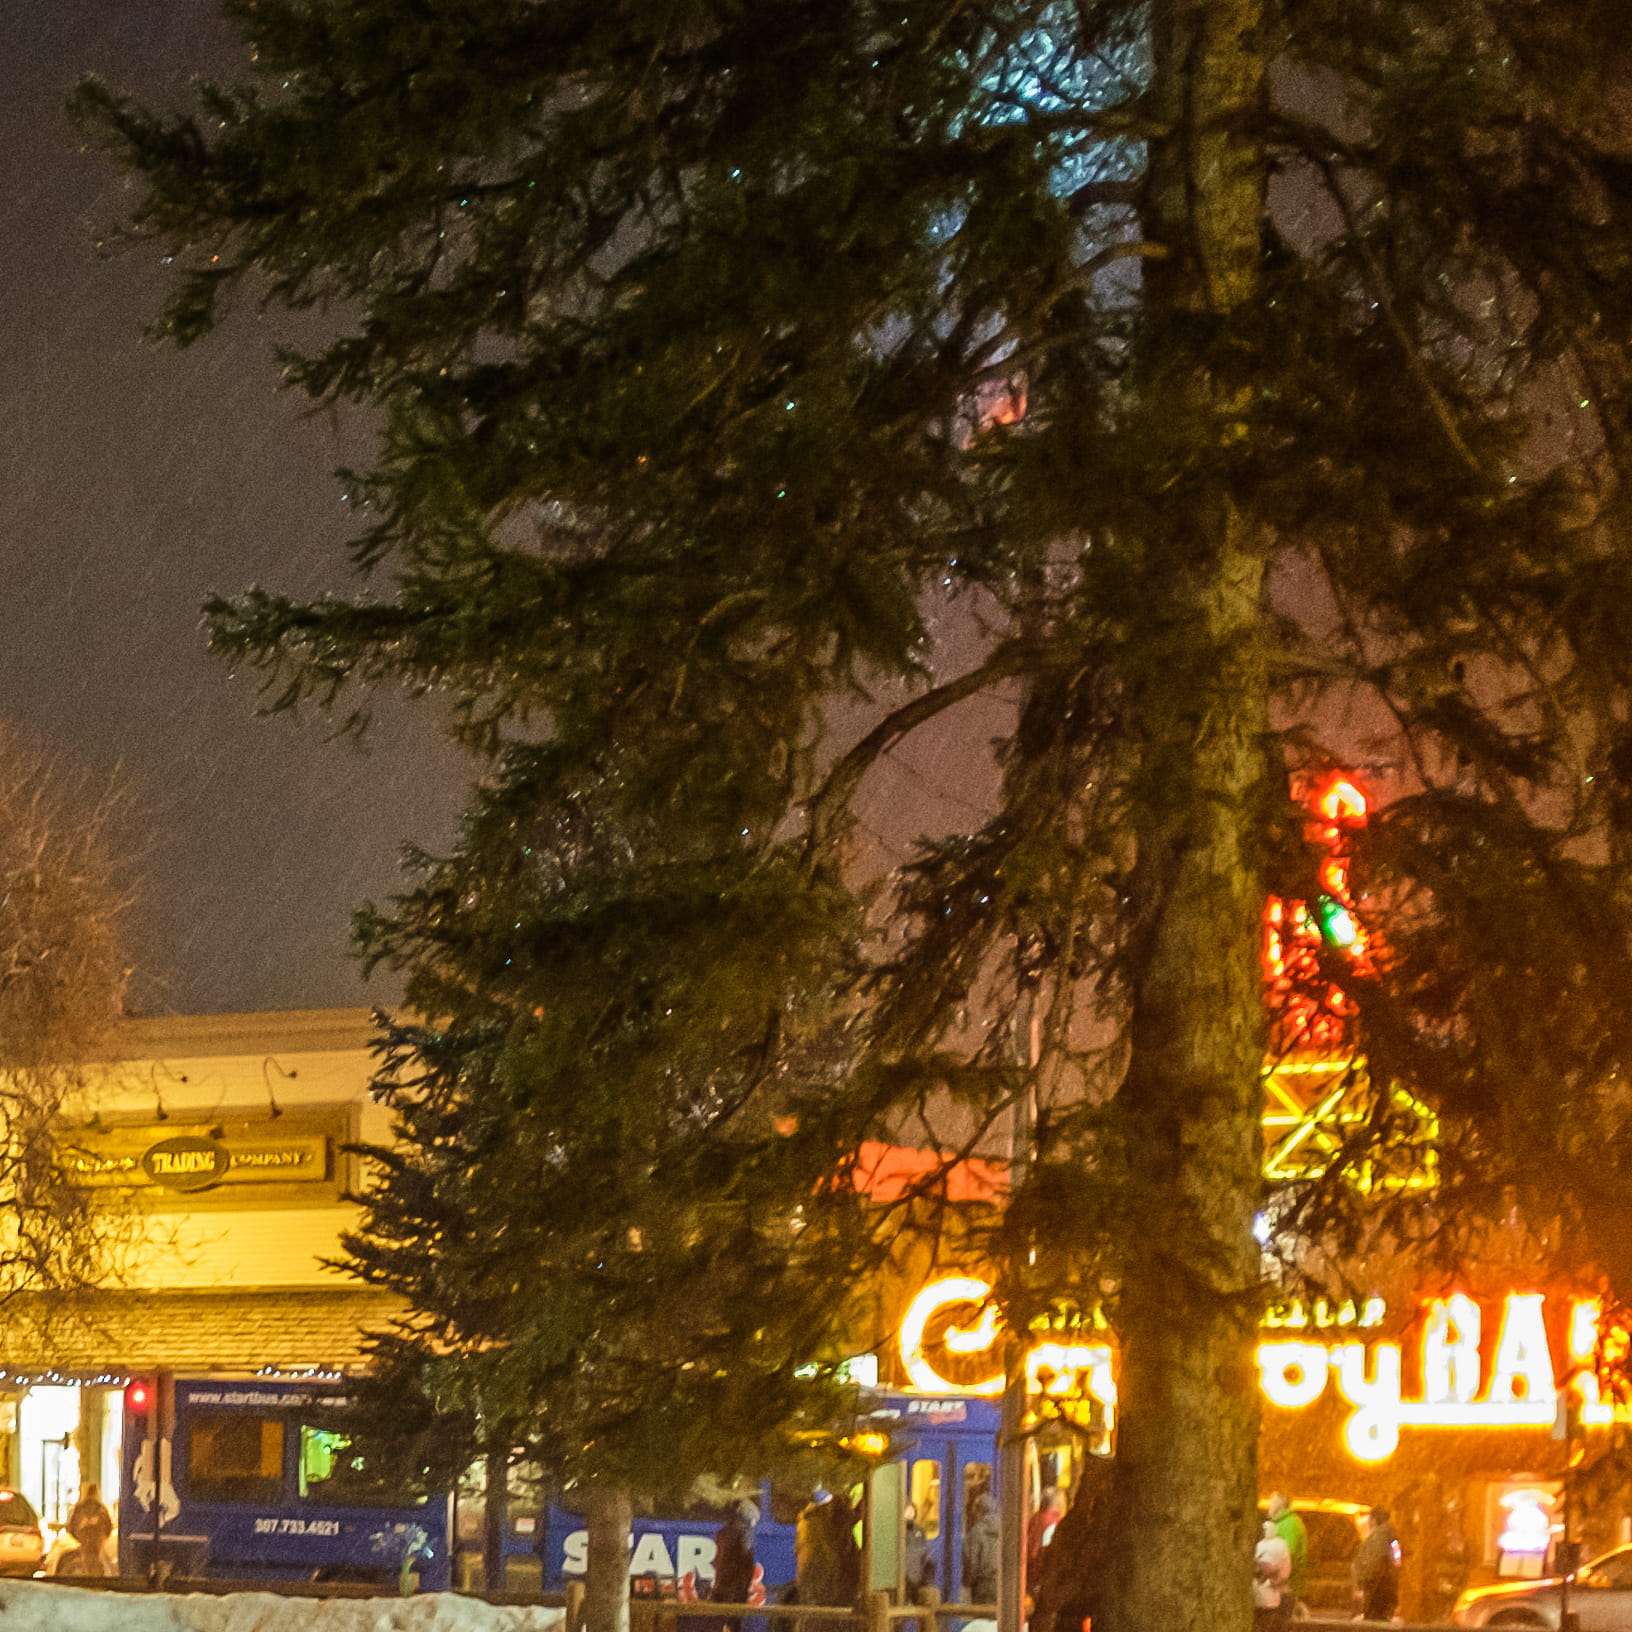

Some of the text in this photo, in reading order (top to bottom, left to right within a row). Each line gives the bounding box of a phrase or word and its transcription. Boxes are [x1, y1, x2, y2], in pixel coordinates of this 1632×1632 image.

[151, 1151, 216, 1174] TRADING
[229, 1152, 303, 1168] COMPANY
[899, 1277, 1402, 1462] Cooy
[562, 1530, 717, 1579] SAR
